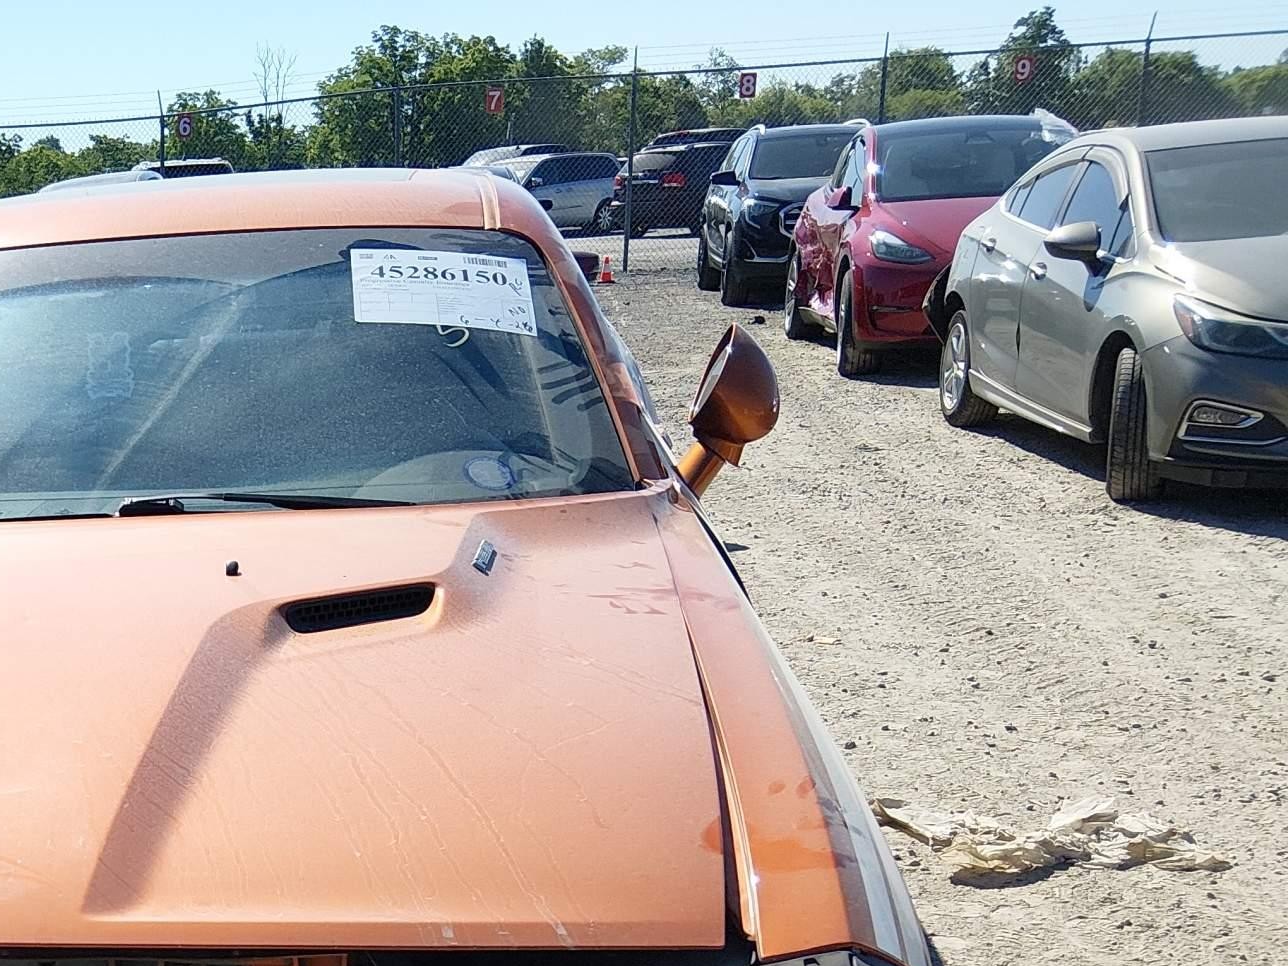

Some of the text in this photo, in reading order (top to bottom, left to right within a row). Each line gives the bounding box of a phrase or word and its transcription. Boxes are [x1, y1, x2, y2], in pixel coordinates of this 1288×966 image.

[1016, 60, 1031, 80] 9
[742, 75, 755, 96] 8
[488, 91, 501, 110] 7
[179, 117, 191, 136] 6
[371, 264, 508, 286] 45286150
